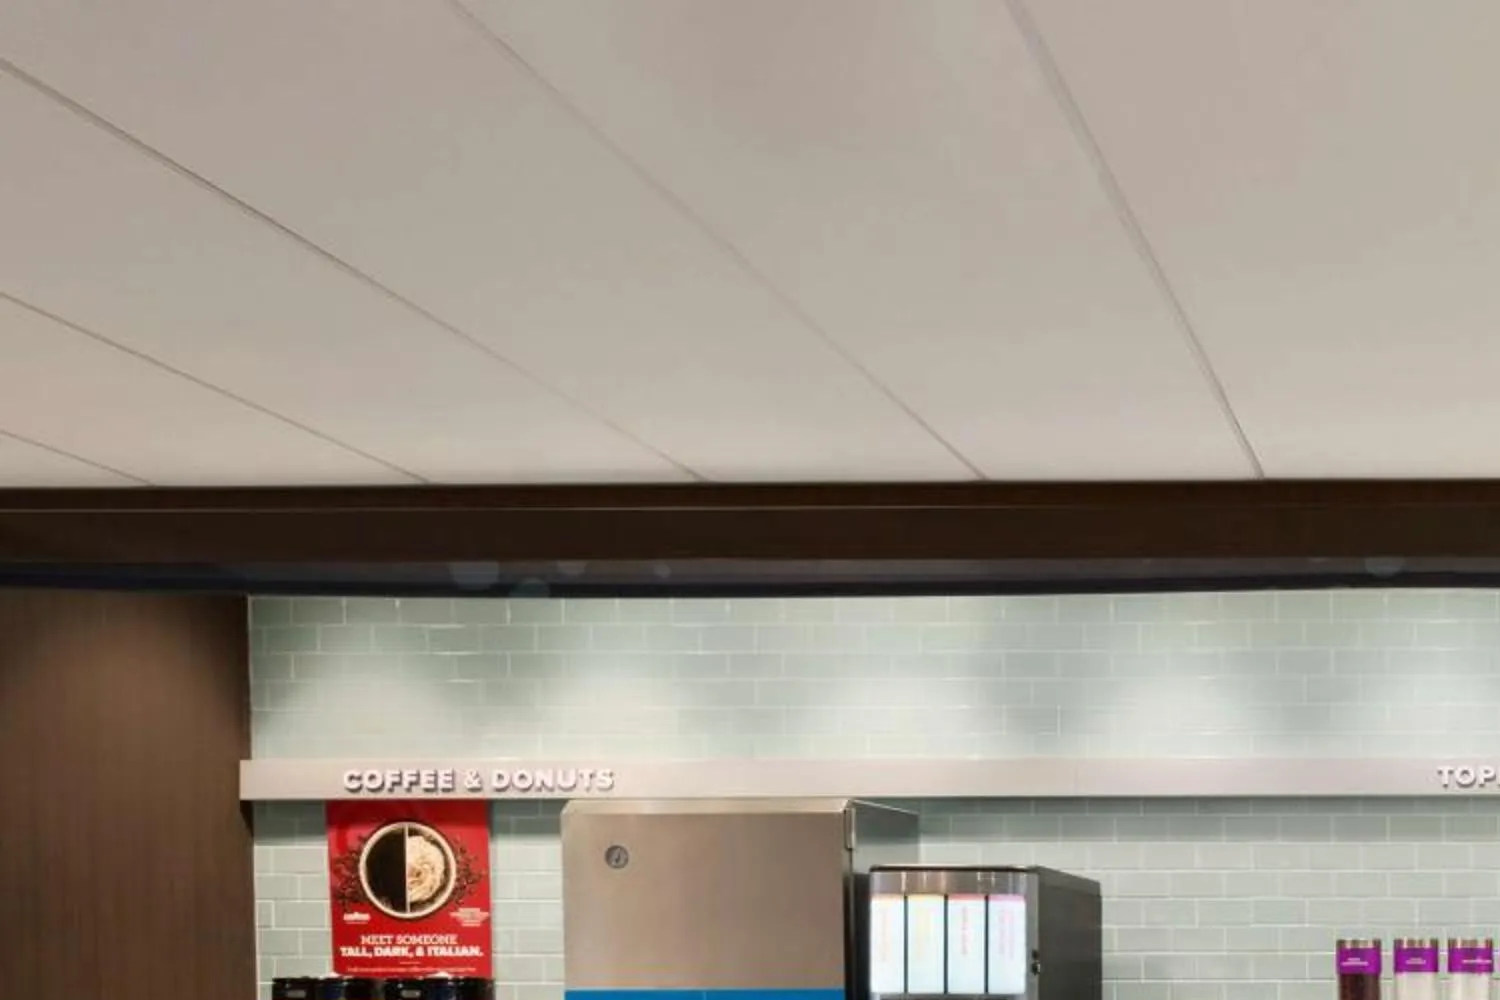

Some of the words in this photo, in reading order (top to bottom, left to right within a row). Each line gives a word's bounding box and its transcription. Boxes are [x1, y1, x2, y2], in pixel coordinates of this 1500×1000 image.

[343, 768, 455, 790] COFFEE
[463, 768, 482, 790] &
[491, 767, 614, 790] DONUTS
[360, 934, 392, 945] MEET
[396, 934, 458, 945] SOMEONE
[340, 946, 373, 958] TALL,
[374, 946, 413, 958] DARK,
[428, 946, 484, 957] ITALIAN.
